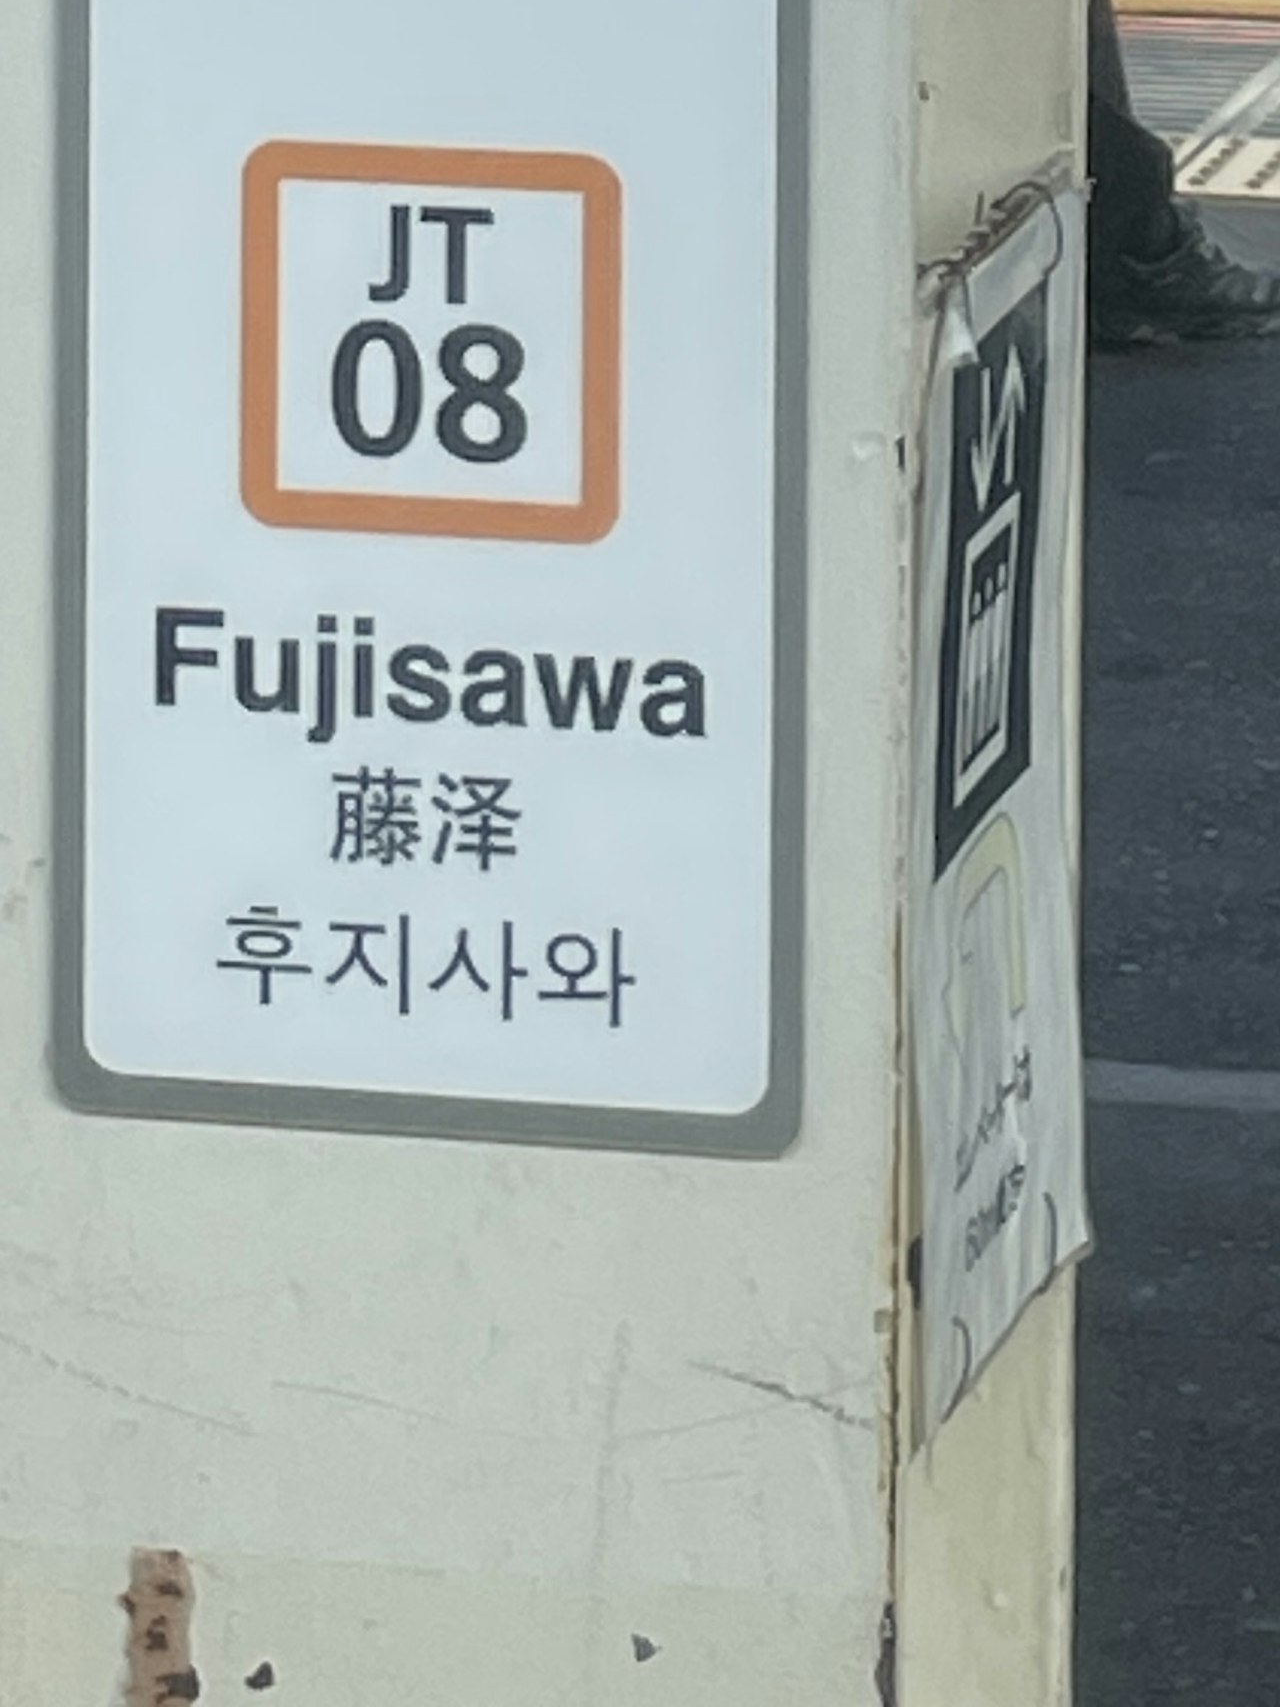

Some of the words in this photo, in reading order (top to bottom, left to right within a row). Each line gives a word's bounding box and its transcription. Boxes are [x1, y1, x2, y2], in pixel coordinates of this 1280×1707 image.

[368, 204, 494, 306] JT
[331, 319, 528, 464] 08
[154, 606, 708, 744] Fujisawa
[330, 765, 522, 872] 藤泽
[216, 905, 636, 1028] 후지사와
